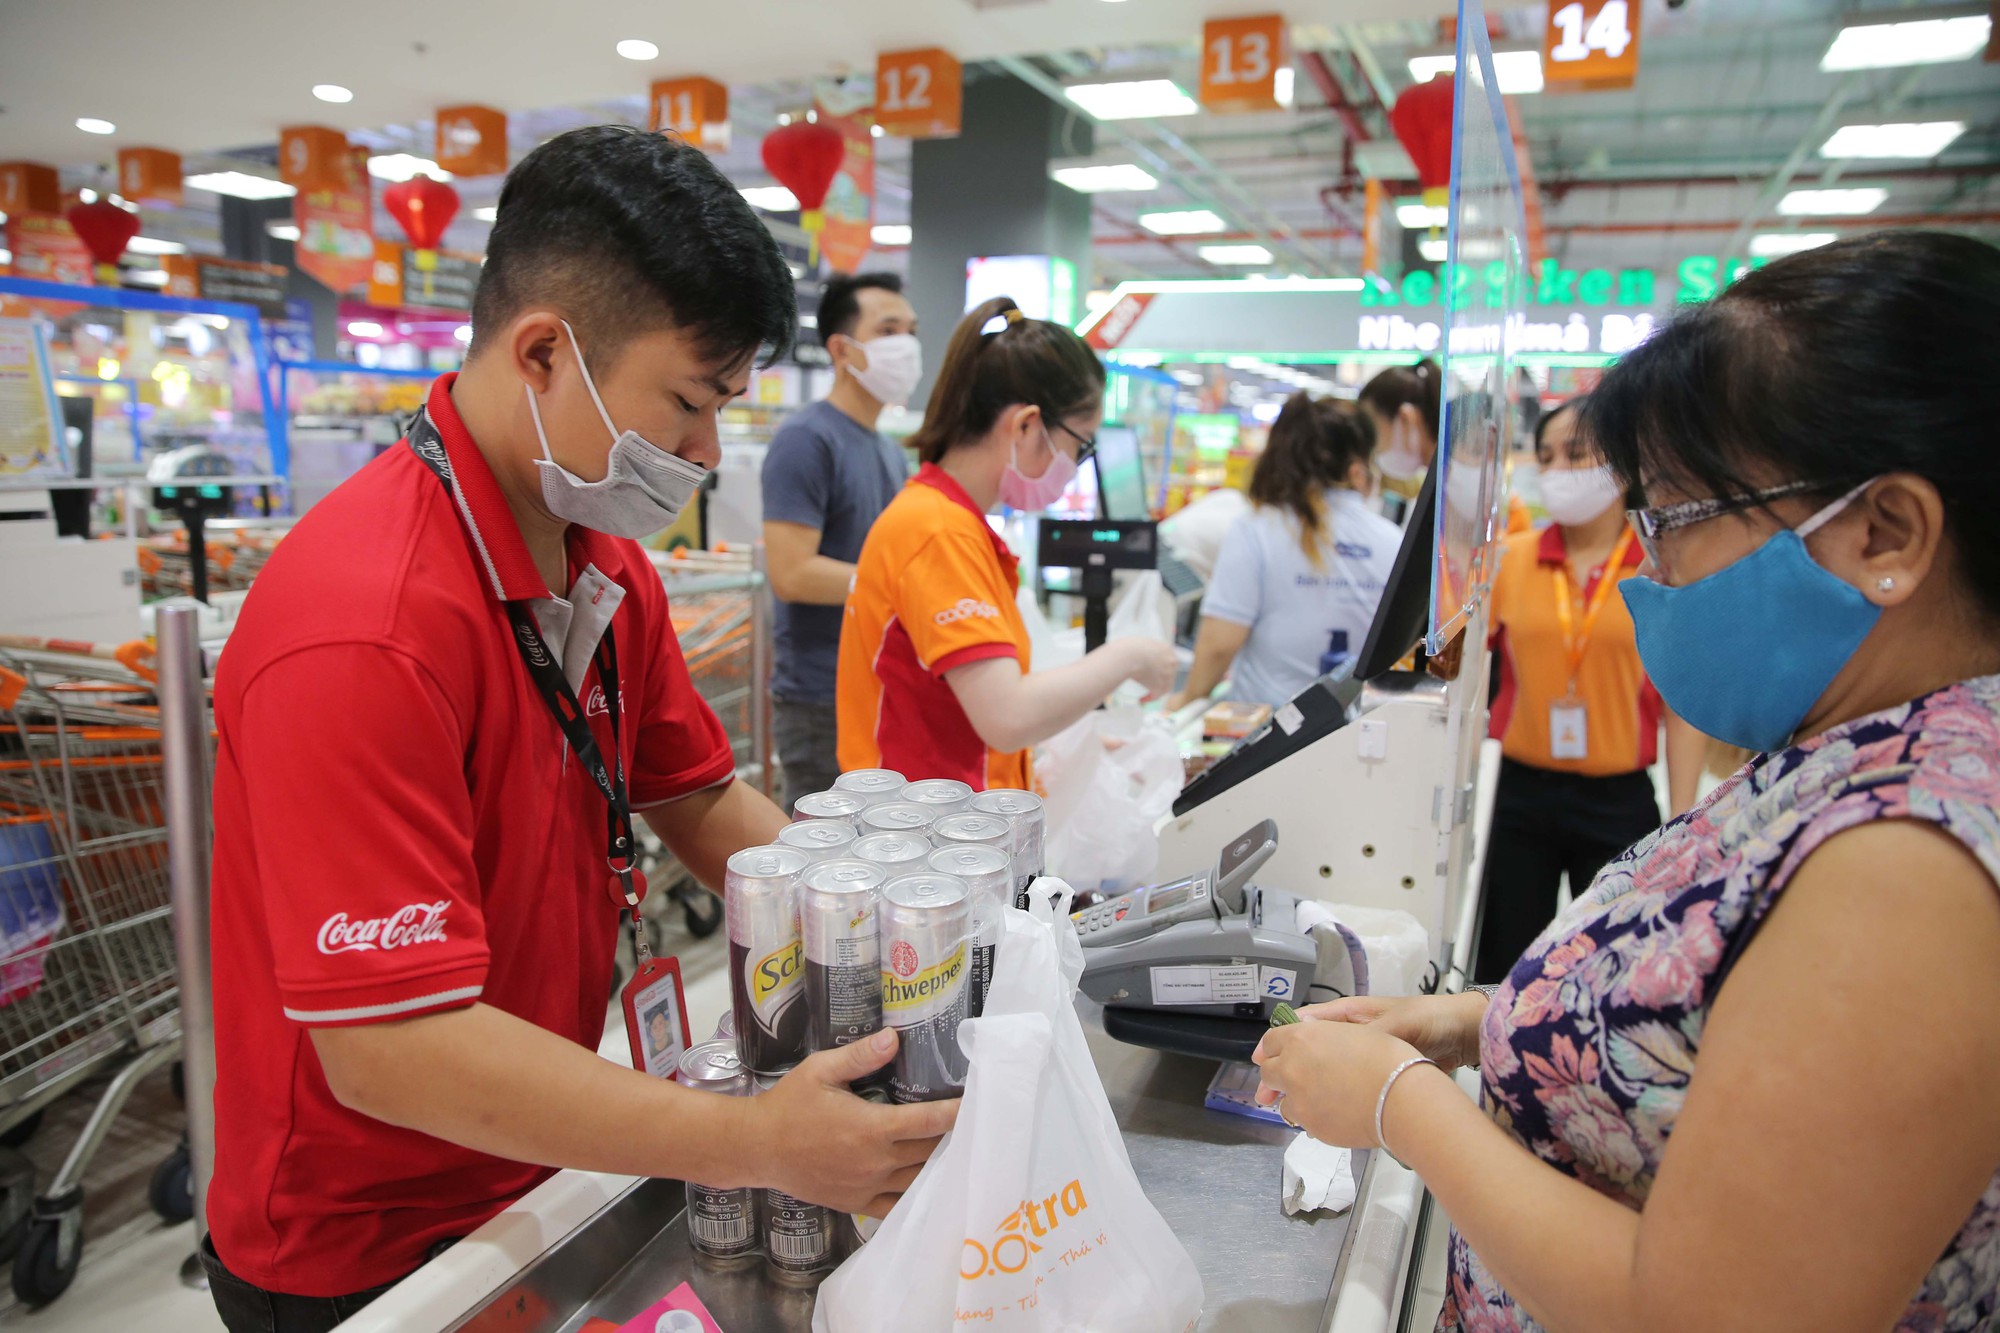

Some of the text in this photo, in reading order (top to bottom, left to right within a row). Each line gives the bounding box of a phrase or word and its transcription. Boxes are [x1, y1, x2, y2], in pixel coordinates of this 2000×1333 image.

[1551, 0, 1632, 62] 14
[1209, 32, 1271, 85] 13
[881, 64, 931, 111] 12
[658, 91, 697, 133] 11
[289, 137, 309, 175] 9
[316, 899, 452, 955] Coca-Cola
[982, 946, 990, 966] WATER
[882, 957, 963, 1004] chweppes
[907, 1082, 931, 1094] Soda
[732, 1210, 741, 1219] ml
[795, 1228, 808, 1236] 320
[809, 1225, 818, 1234] ml
[1059, 1240, 1092, 1267] Thú
